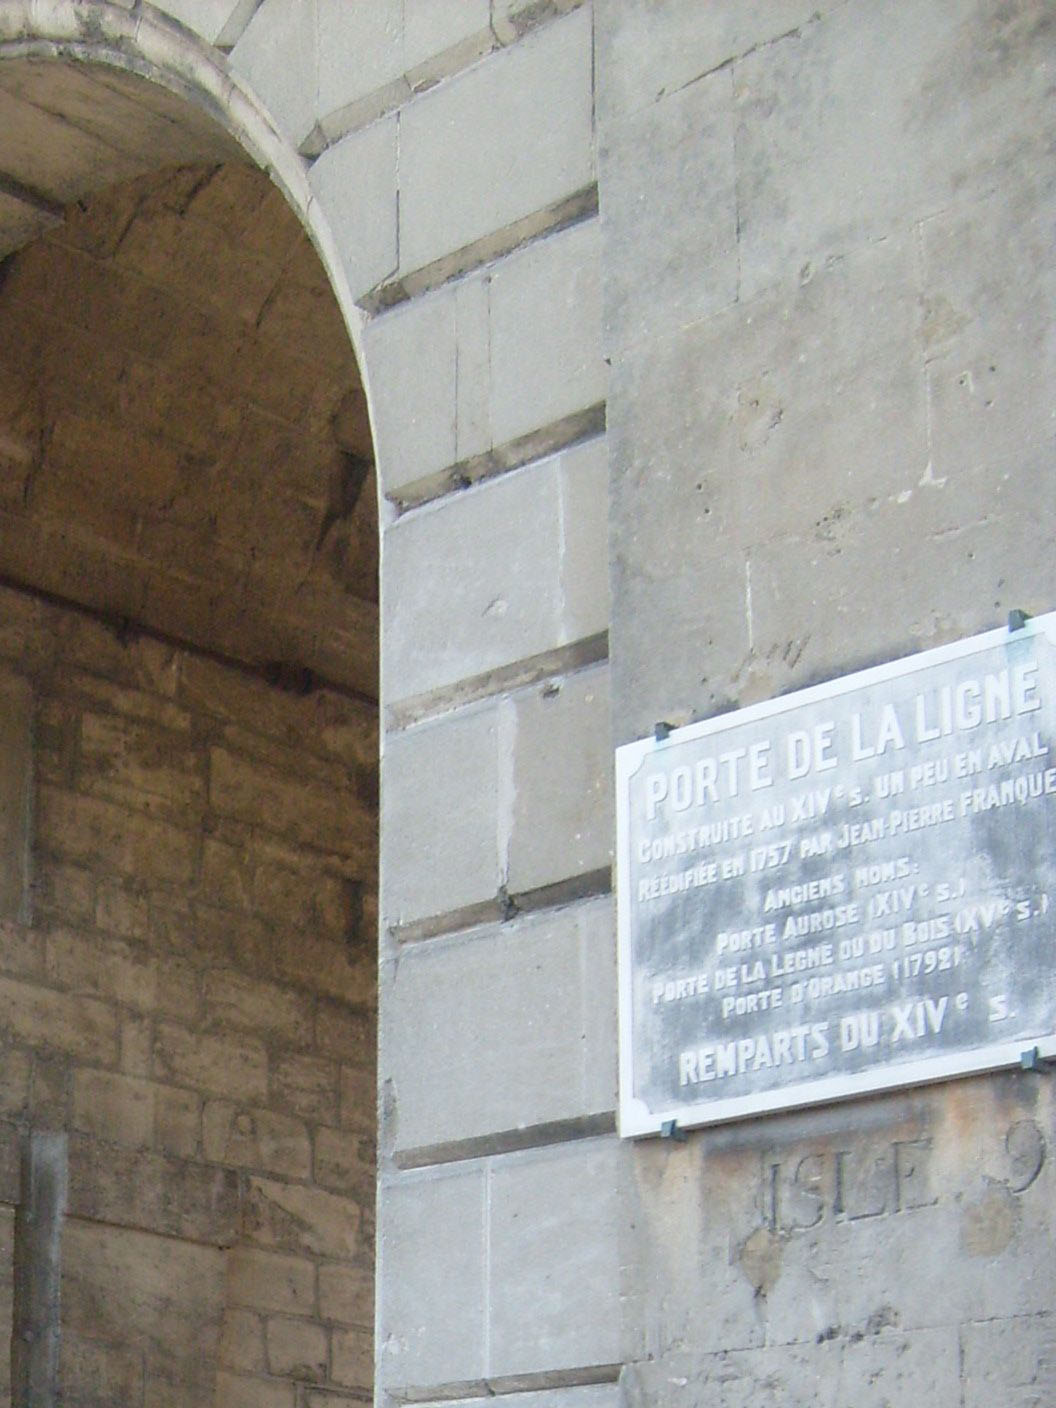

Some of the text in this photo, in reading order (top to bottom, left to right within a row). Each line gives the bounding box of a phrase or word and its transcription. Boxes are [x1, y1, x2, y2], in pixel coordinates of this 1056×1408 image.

[646, 660, 1042, 822] PORTE DE LA LIGNE
[639, 814, 753, 863] CONSTRUITE
[760, 805, 785, 832] AU
[875, 770, 904, 799] UN
[911, 758, 948, 790] PEU
[956, 750, 982, 779] EN
[987, 732, 1049, 770] AVAL
[723, 857, 744, 881] EN
[751, 839, 793, 873] 1757
[800, 833, 833, 859] PAR
[837, 799, 955, 849] JEAN-PIERRE
[717, 924, 776, 954] PORTE
[782, 903, 860, 941] AUROSE
[764, 873, 845, 913] ANCIENS
[653, 974, 709, 1004] PORTE
[715, 967, 737, 991] DE
[741, 961, 766, 985] LA
[839, 936, 864, 961] OU
[869, 929, 896, 954] DU
[902, 913, 952, 947] BOIS
[722, 988, 782, 1018] PORTE
[791, 964, 885, 1004] D'ORANGE
[679, 1021, 830, 1087] REMPARTS
[840, 1012, 880, 1051] DU
